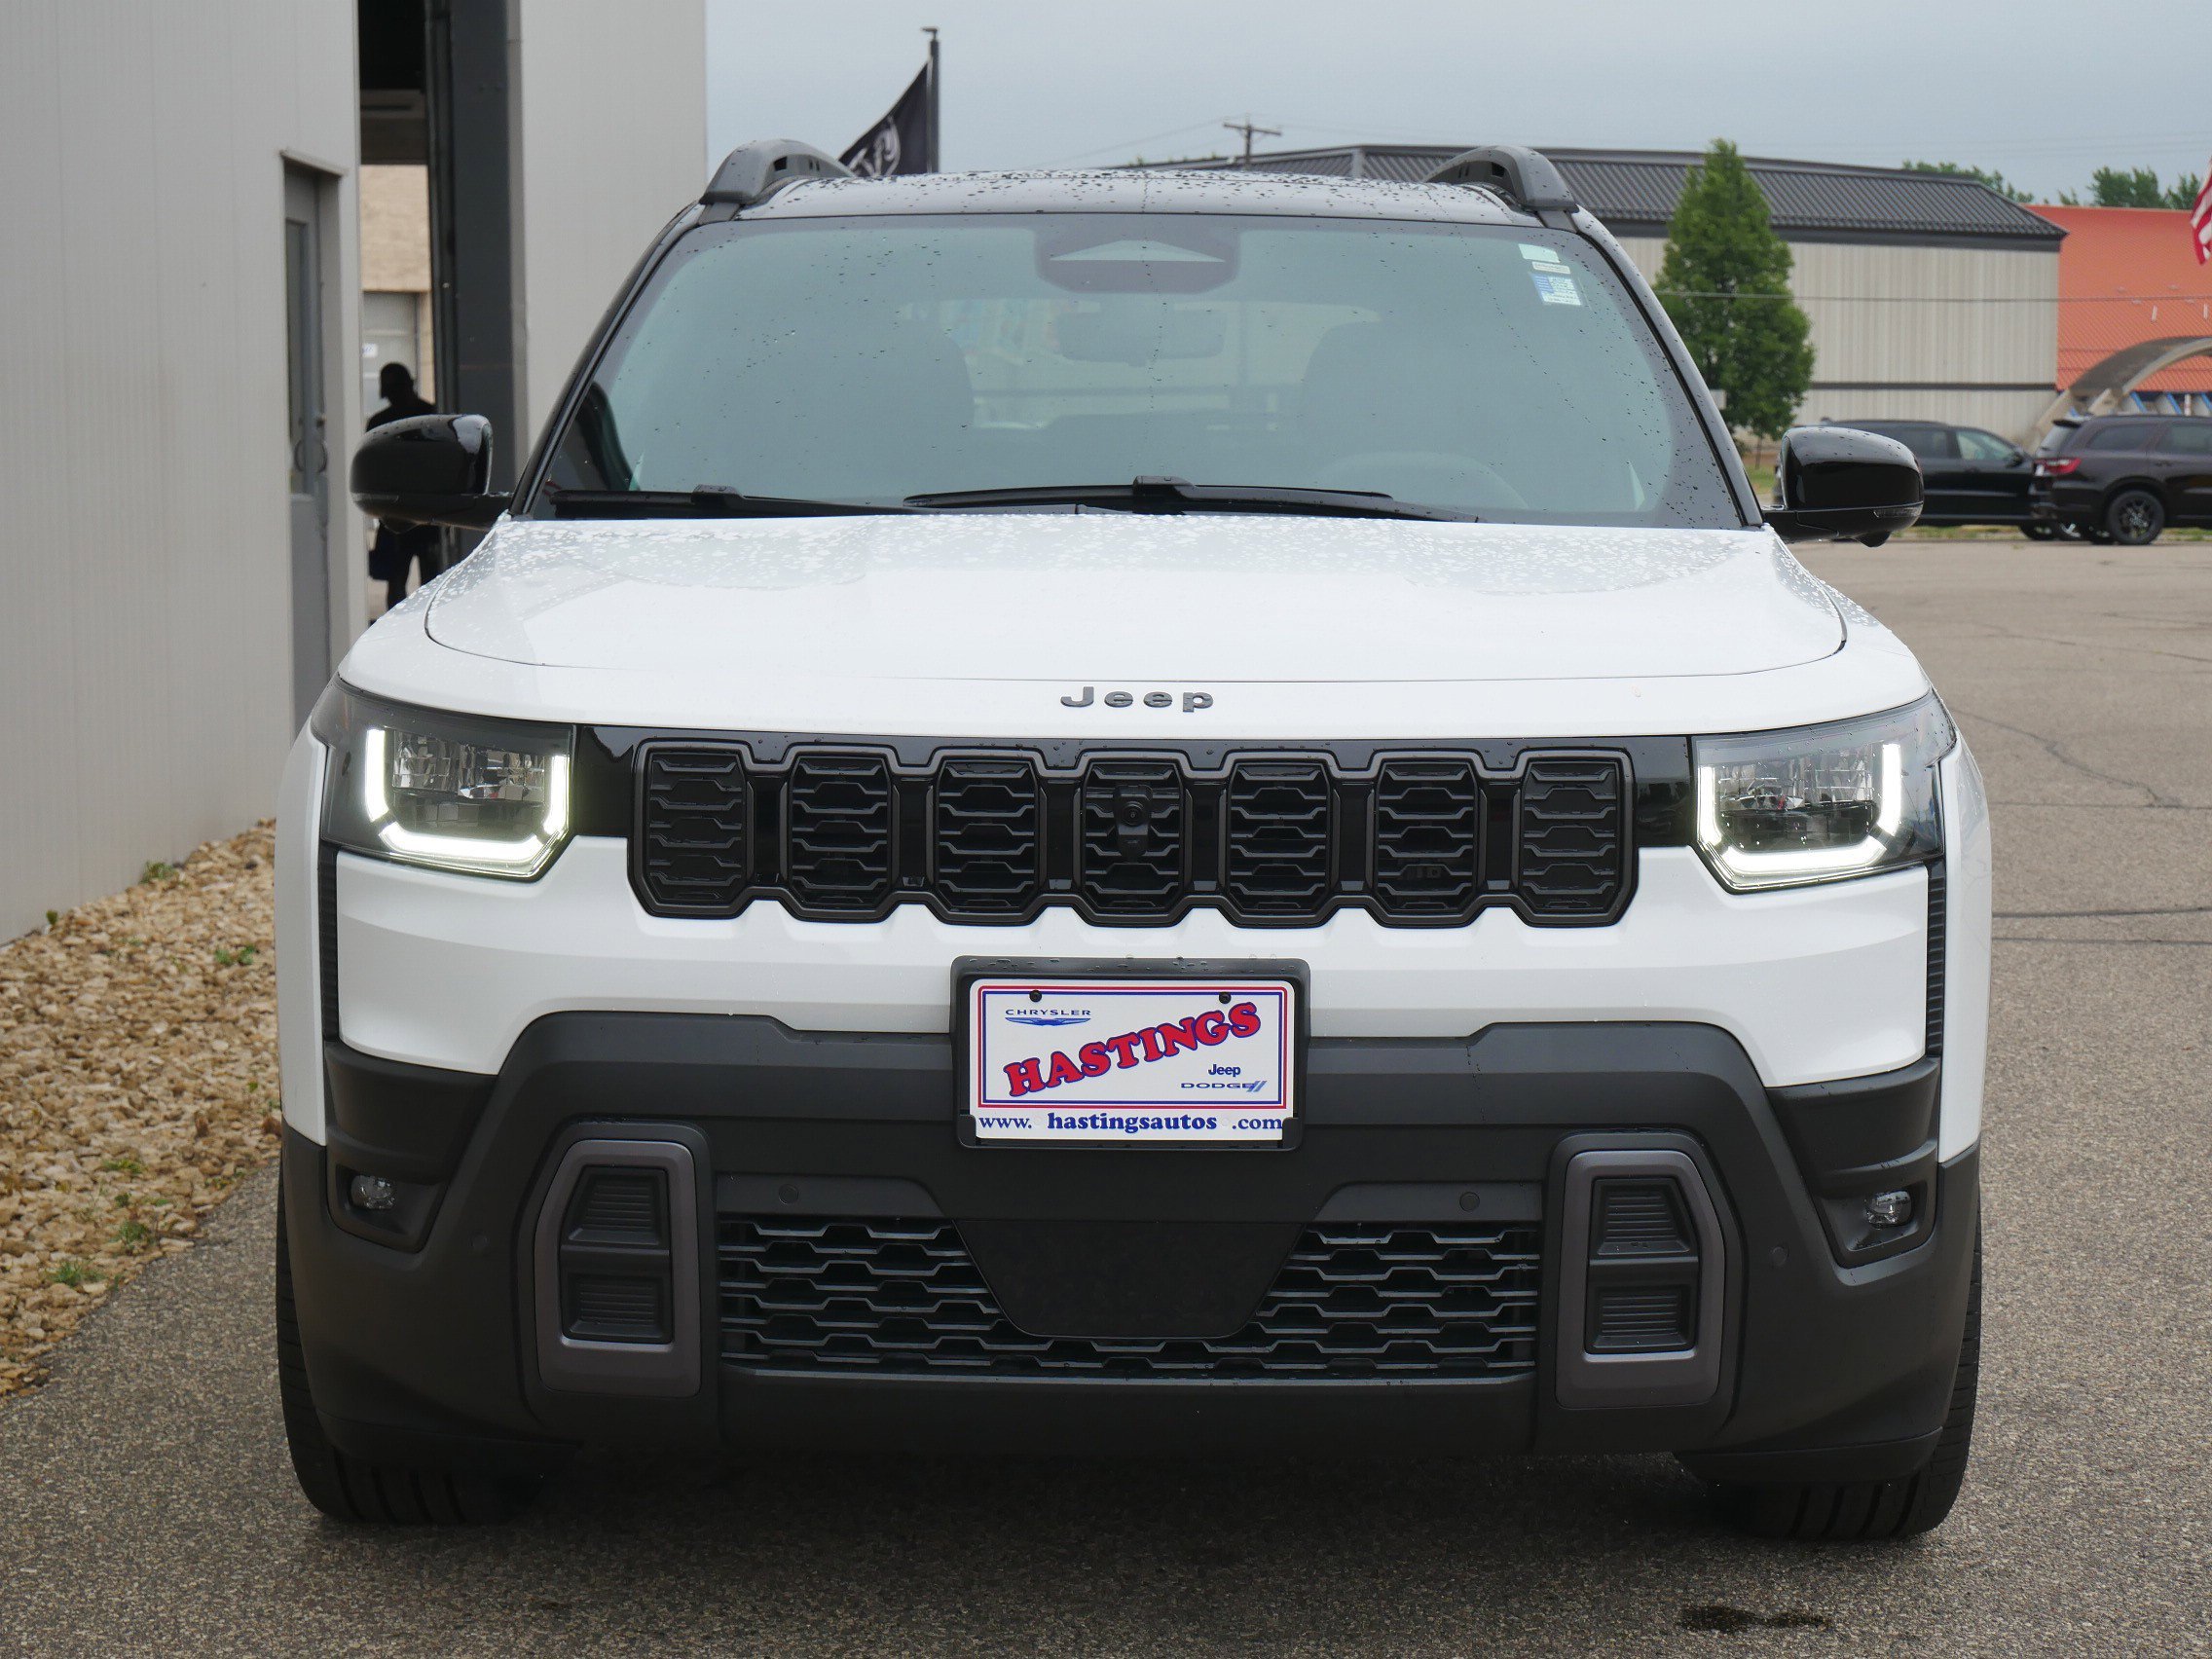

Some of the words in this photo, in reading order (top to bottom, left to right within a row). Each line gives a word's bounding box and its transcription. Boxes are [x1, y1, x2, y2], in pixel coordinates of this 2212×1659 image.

[1059, 685, 1214, 713] Jeep
[1002, 1001, 1262, 1098] HASTINGS
[1207, 1063, 1241, 1078] Jeep
[978, 1117, 1032, 1129] www.
[1047, 1112, 1218, 1133] hastingsautos
[1232, 1118, 1283, 1129] .com
